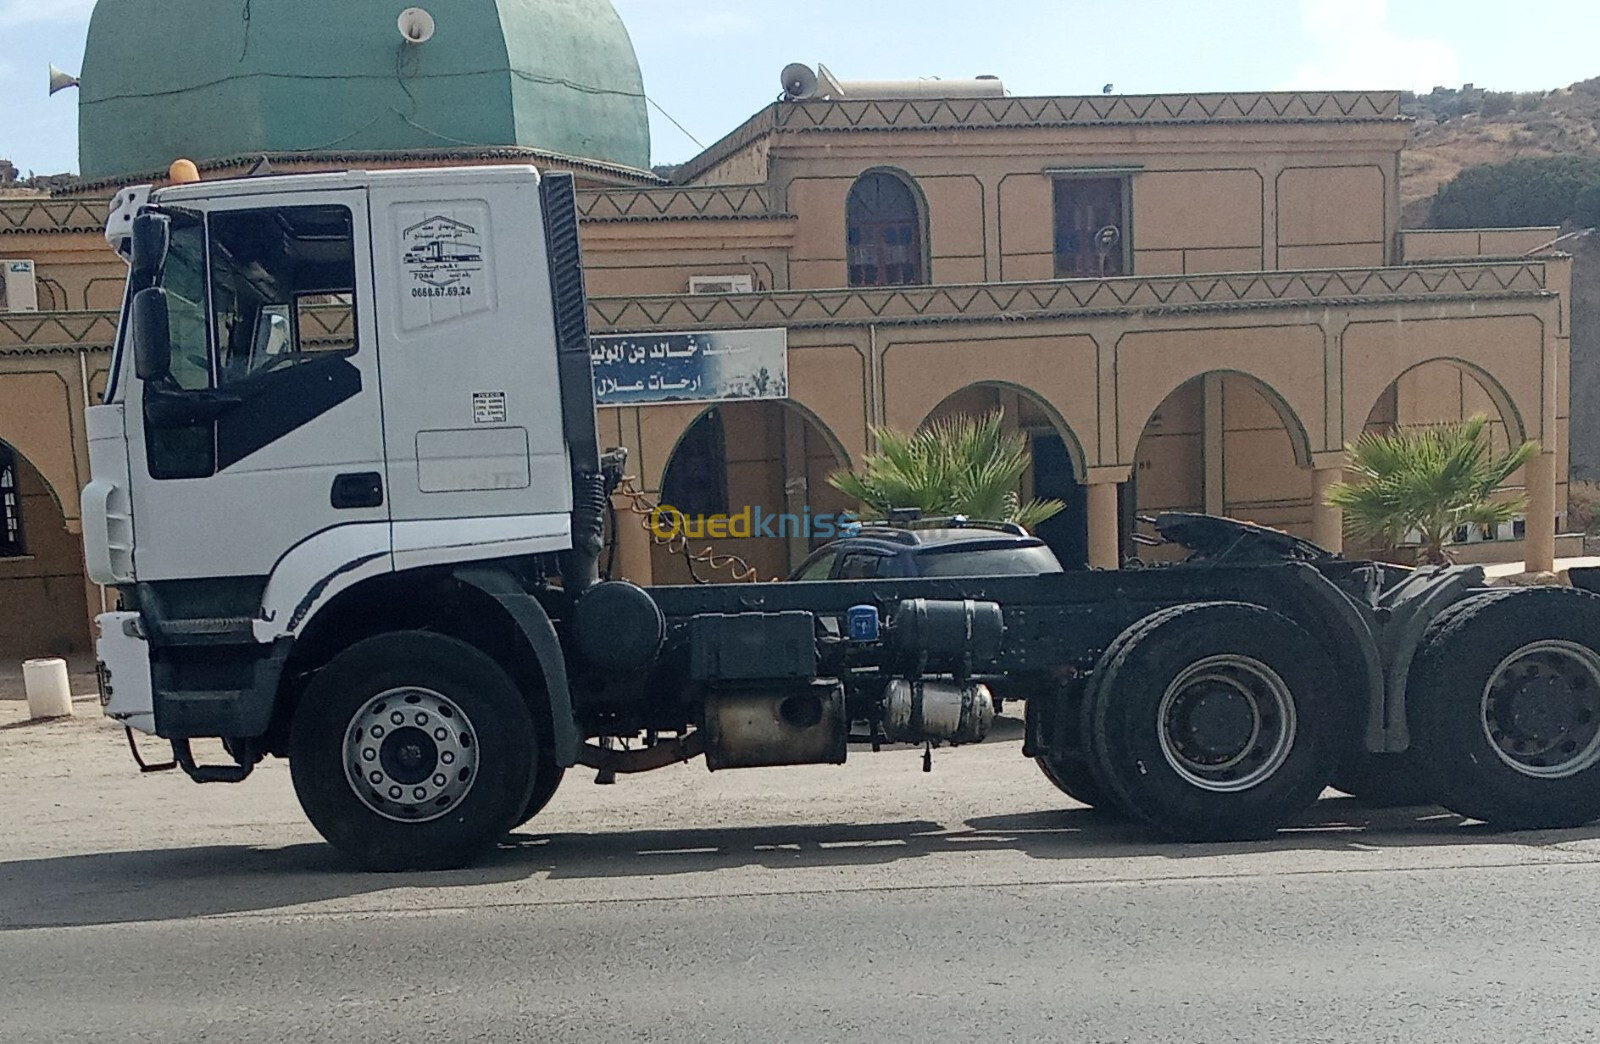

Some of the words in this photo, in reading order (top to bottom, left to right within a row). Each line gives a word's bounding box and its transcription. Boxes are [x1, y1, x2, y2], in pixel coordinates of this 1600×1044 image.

[591, 344, 625, 366] الولي
[628, 344, 646, 364] بن
[649, 339, 698, 358] خالد
